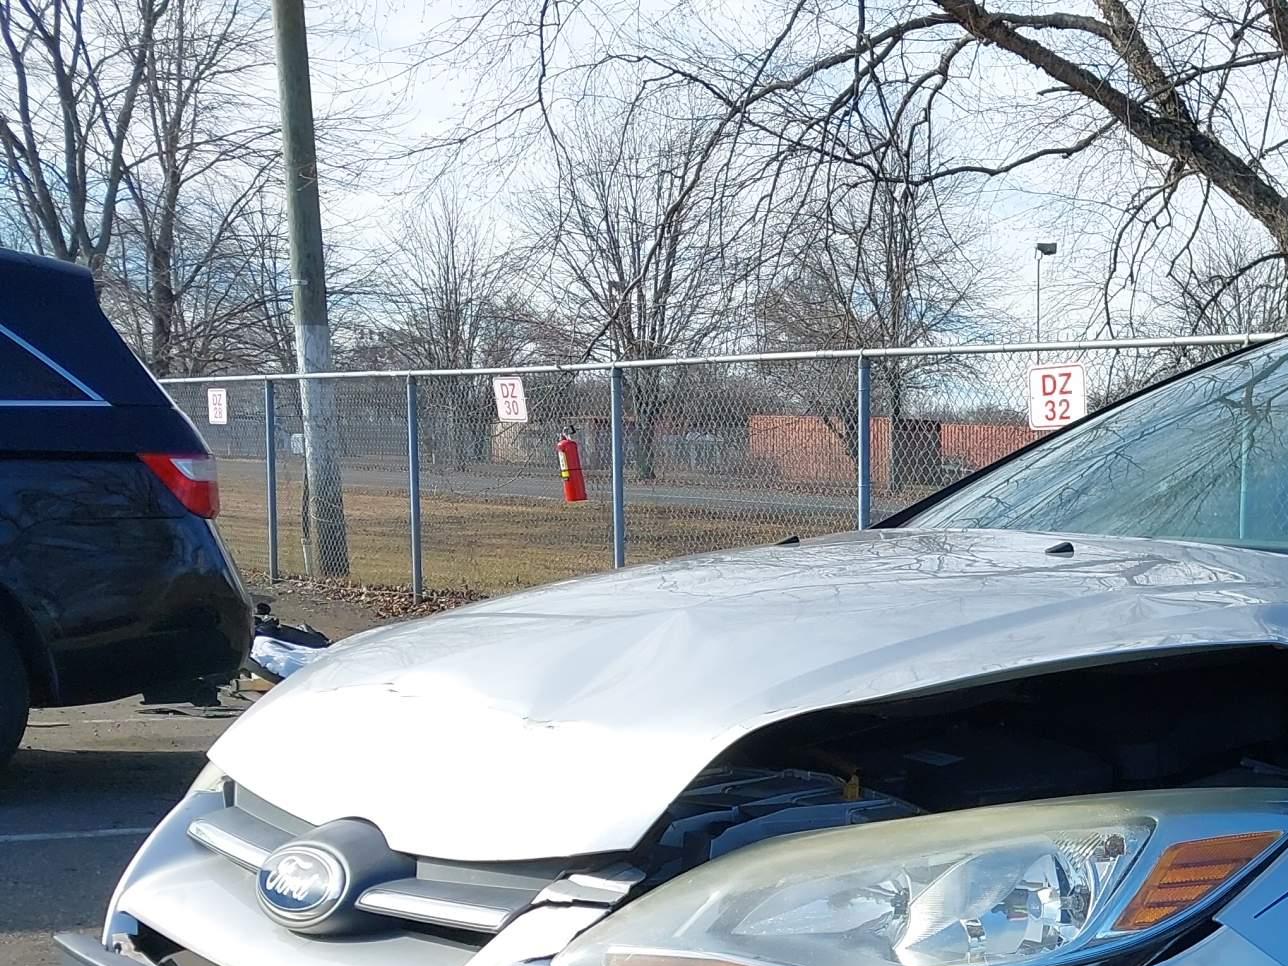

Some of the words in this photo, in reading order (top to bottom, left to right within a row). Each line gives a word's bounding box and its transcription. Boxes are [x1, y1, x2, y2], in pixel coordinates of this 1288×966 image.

[500, 383, 518, 398] DZ
[1041, 372, 1073, 396] DZ
[504, 400, 519, 415] 30
[1044, 399, 1071, 421] 32
[266, 856, 321, 901] Ford
